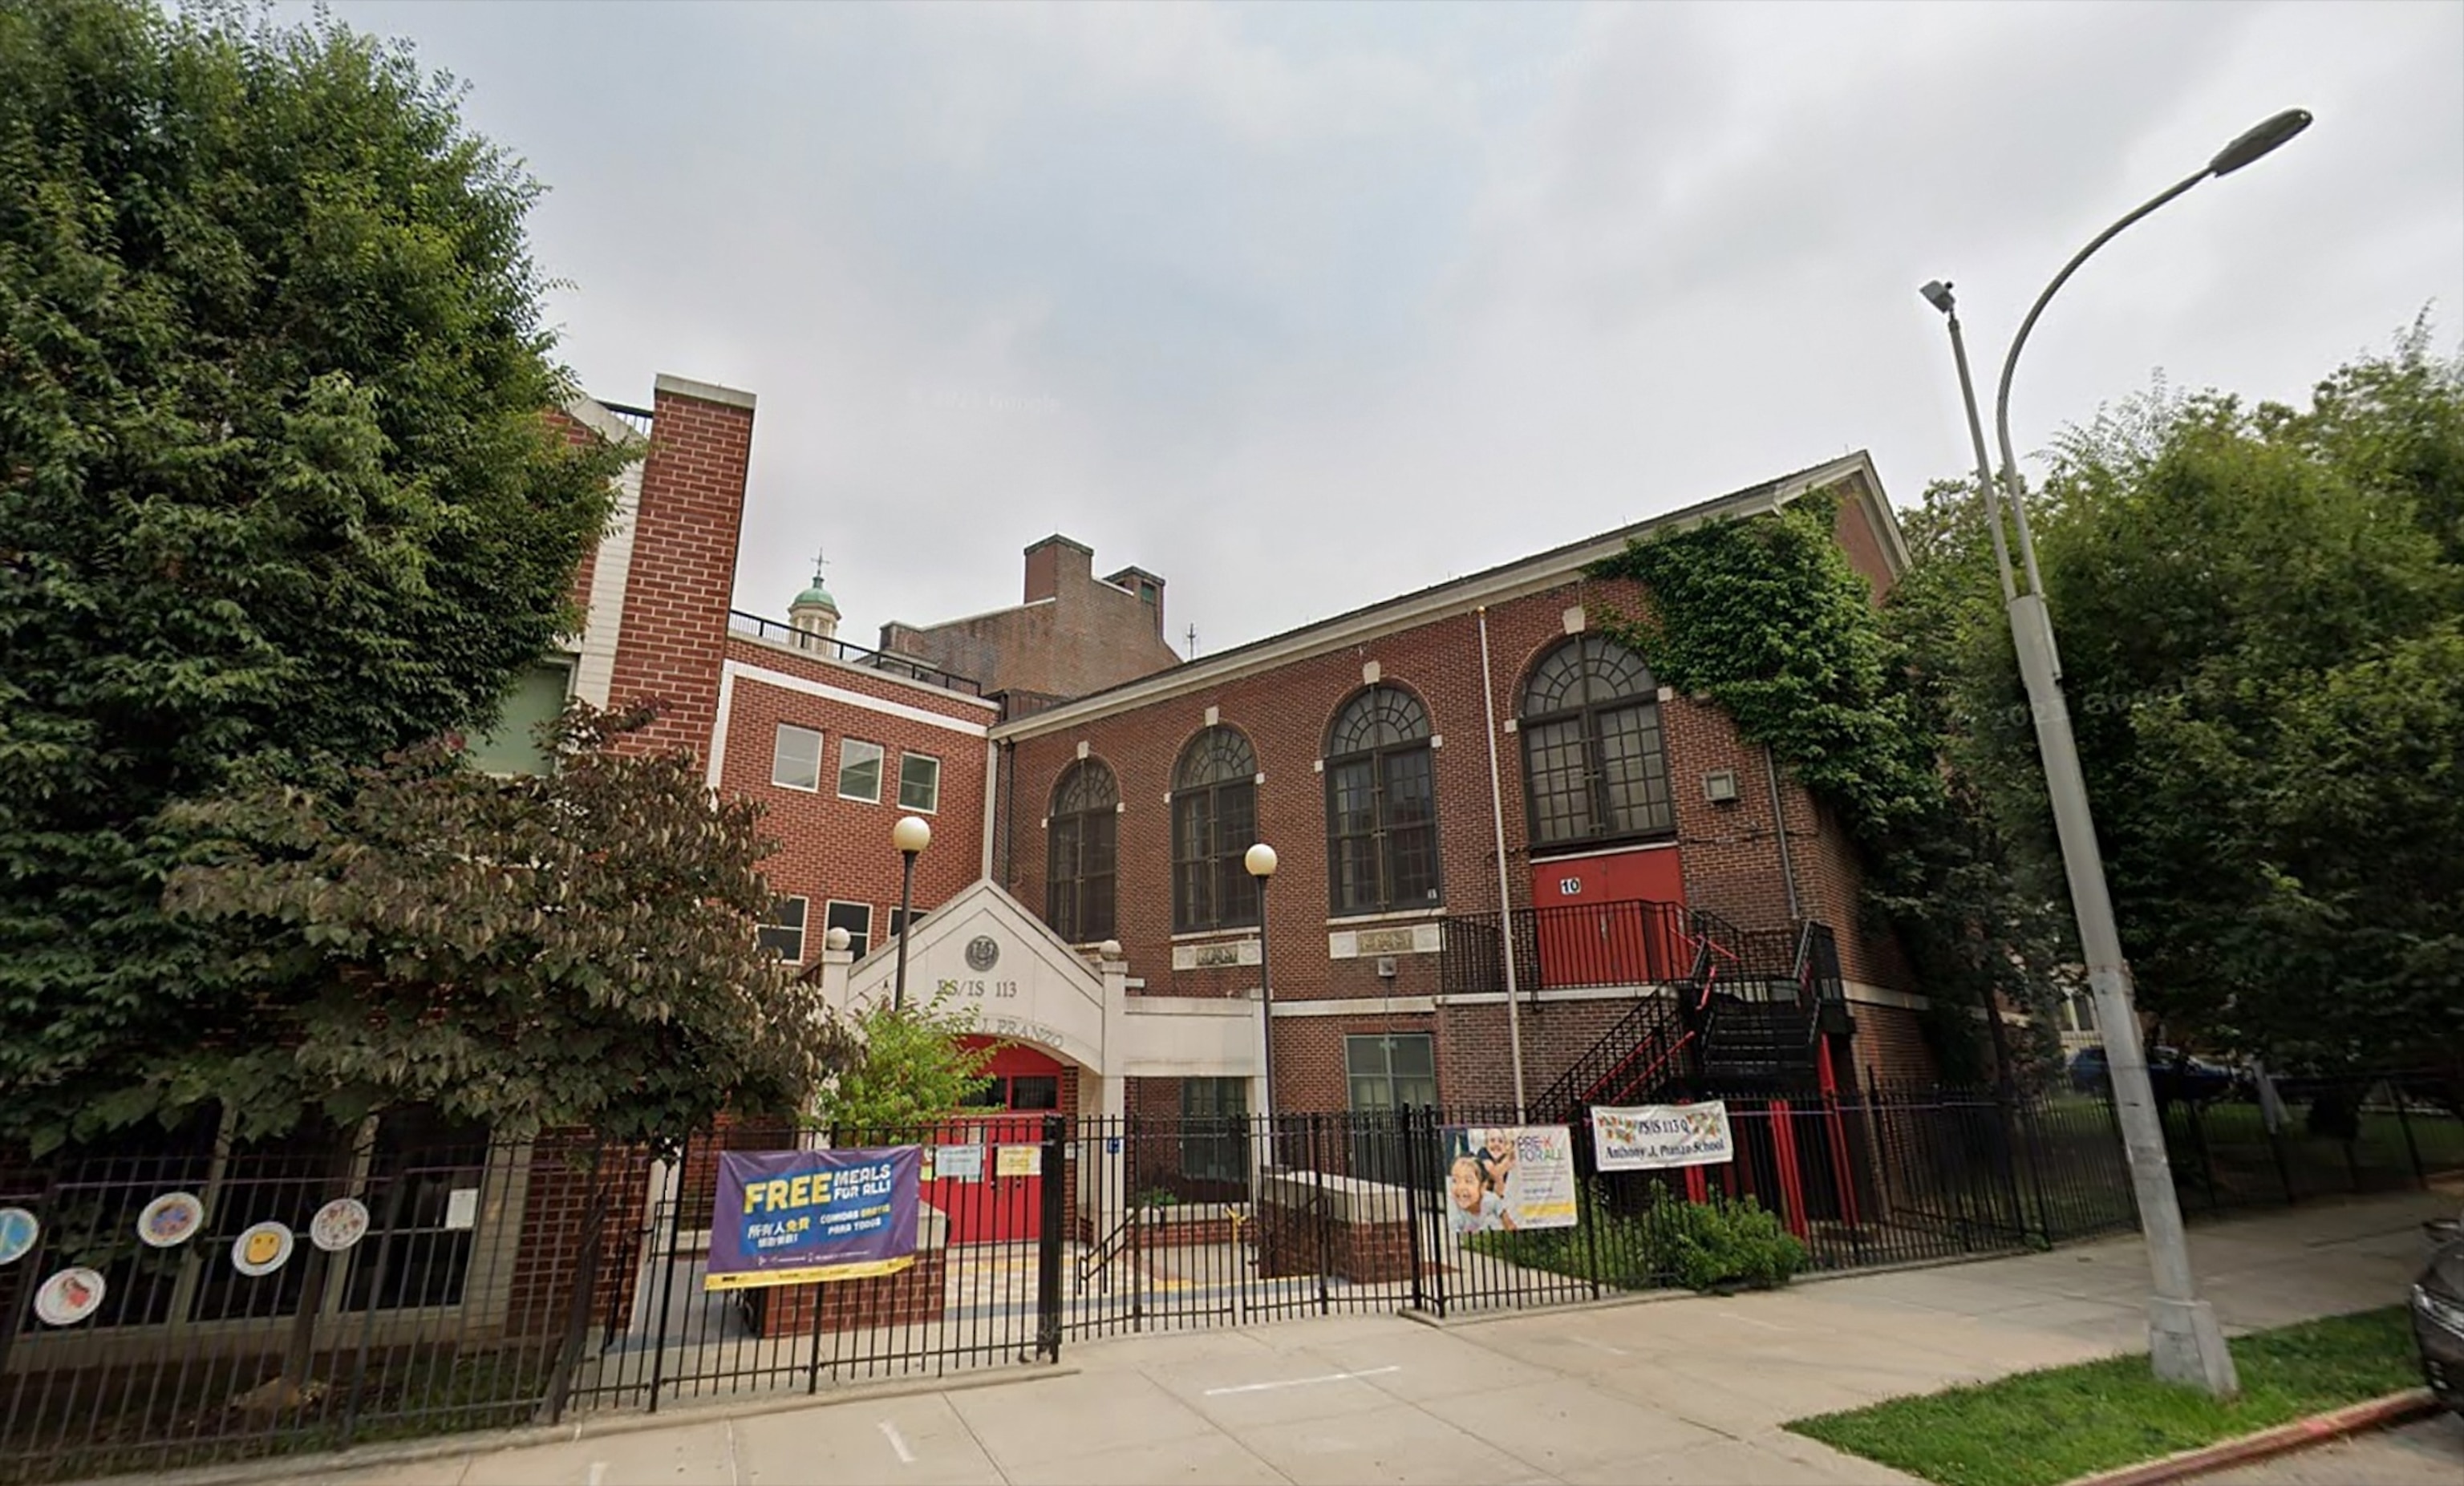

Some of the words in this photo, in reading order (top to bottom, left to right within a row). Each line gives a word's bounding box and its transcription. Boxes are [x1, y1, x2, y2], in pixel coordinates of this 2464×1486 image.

[1562, 879, 1579, 893] 10
[995, 981, 1018, 998] 113
[997, 1018, 1064, 1048] PRANZO
[1517, 1136, 1553, 1150] PRE-K
[1692, 1139, 1724, 1153] School
[834, 1164, 891, 1188] MEALS
[744, 1172, 833, 1213] FREE
[833, 1185, 859, 1201] FOR
